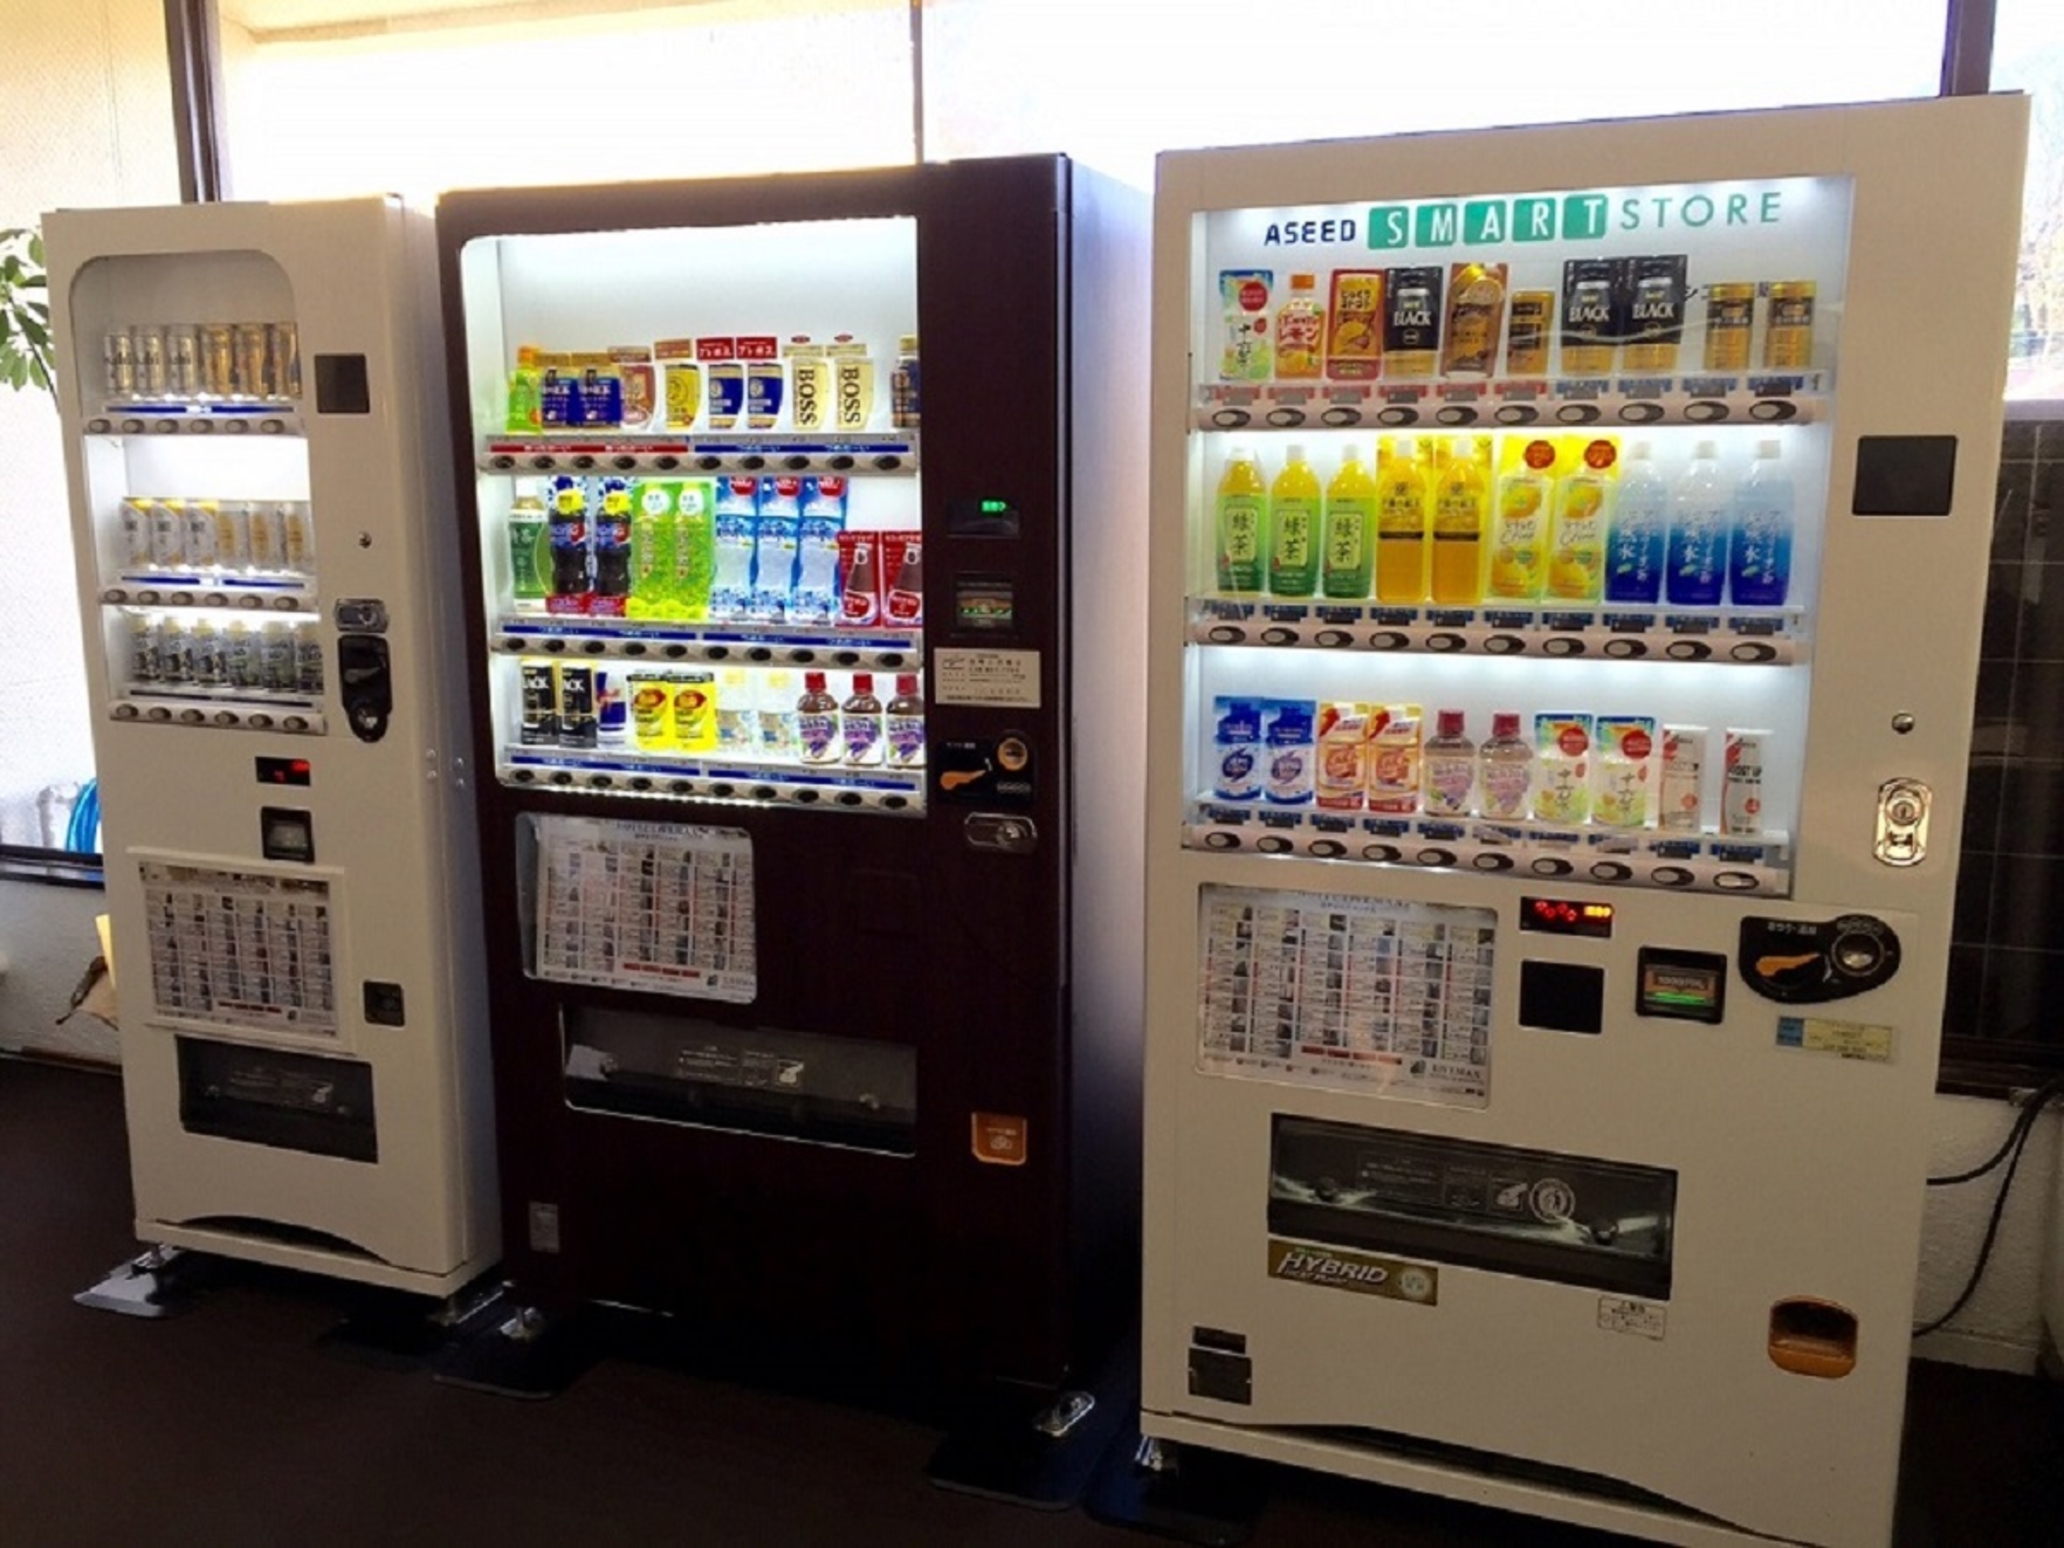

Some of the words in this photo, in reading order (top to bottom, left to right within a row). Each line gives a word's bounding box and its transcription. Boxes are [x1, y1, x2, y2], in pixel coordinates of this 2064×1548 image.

[1264, 220, 1356, 246] ASEED
[1380, 198, 1605, 247] SMART
[1620, 192, 1782, 230] STORE
[1394, 311, 1432, 327] BLACK
[1568, 304, 1610, 323] BLACK
[1632, 302, 1674, 319] BLACK
[799, 368, 818, 426] BOSS
[842, 367, 861, 424] BOSS
[1277, 1252, 1389, 1283] HYBRID
